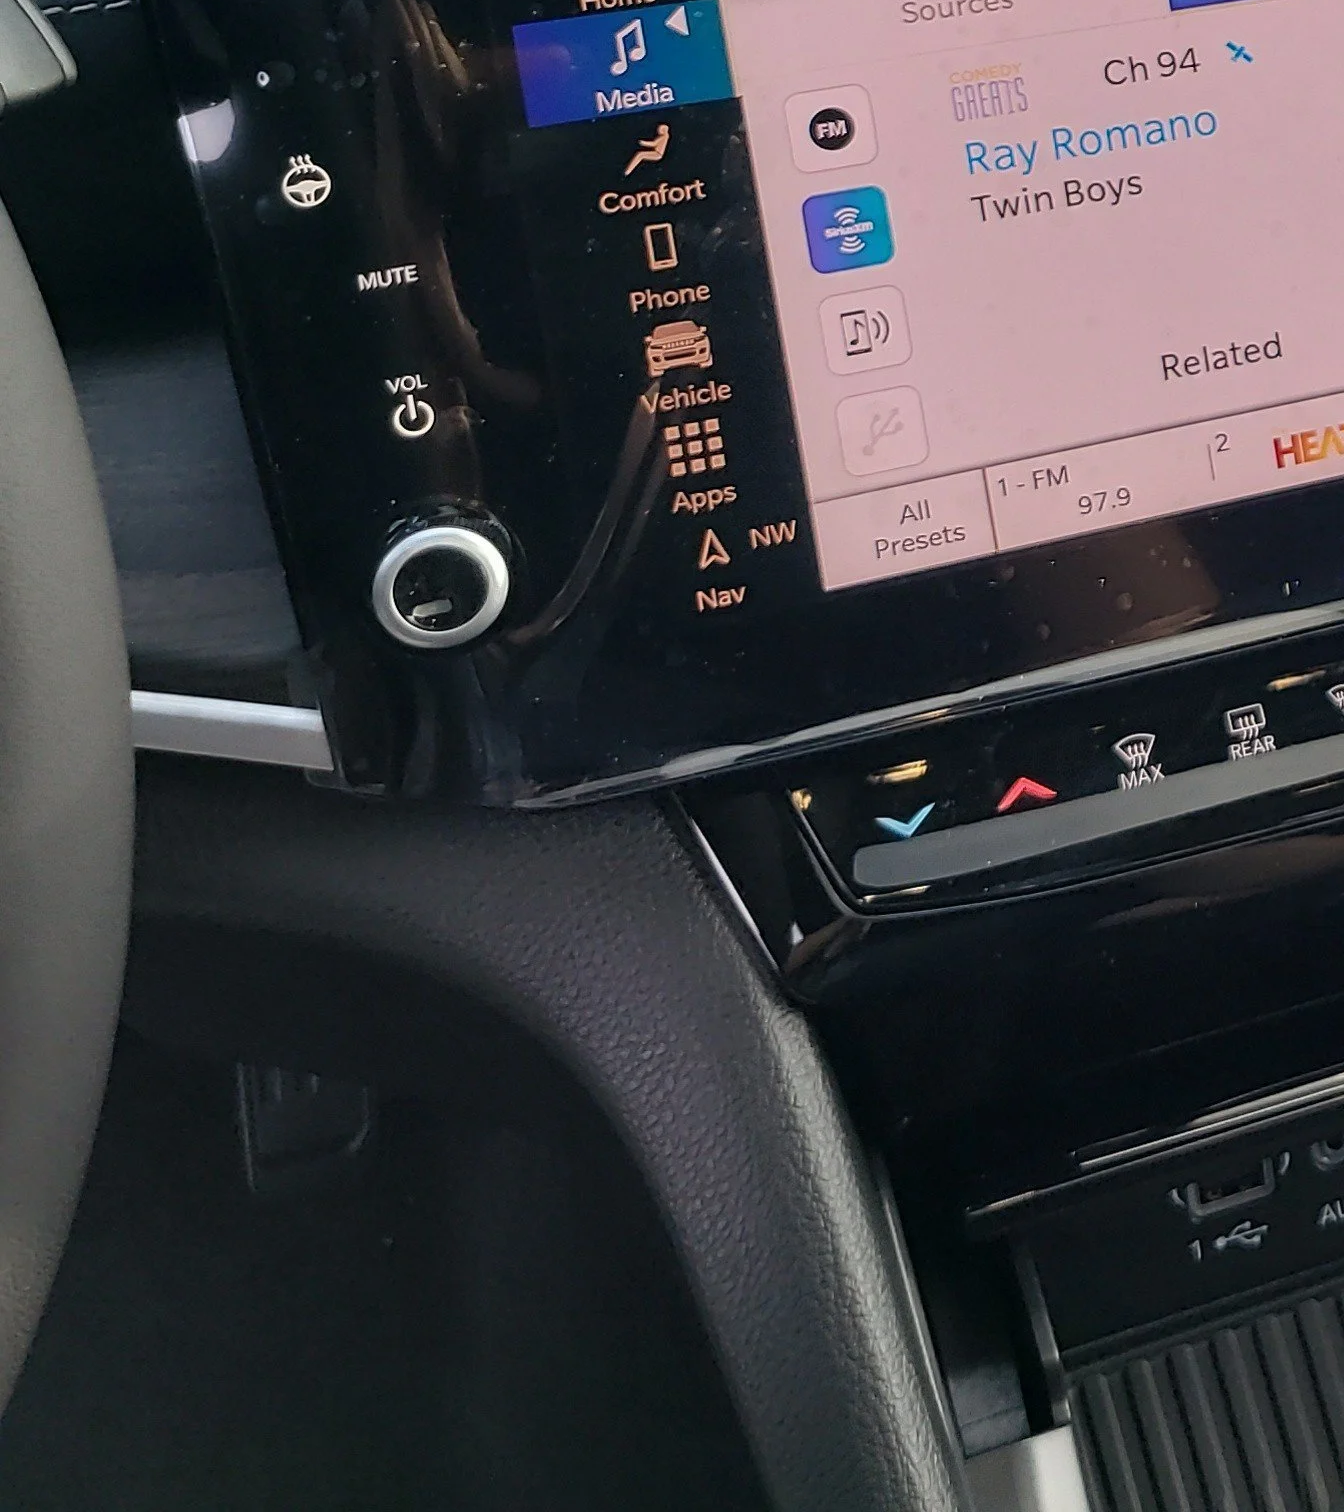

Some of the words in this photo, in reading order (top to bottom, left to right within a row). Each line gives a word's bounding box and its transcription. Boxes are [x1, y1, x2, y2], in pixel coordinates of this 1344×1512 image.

[949, 63, 1021, 83] COMEDY
[1103, 56, 1151, 86] Ch
[1158, 47, 1202, 78] 94
[595, 83, 676, 114] Media
[951, 77, 1028, 121] GREATS
[815, 119, 847, 139] FM
[965, 134, 1040, 177] Ray
[1053, 108, 1219, 158] Romano
[600, 179, 707, 215] Comfort
[970, 186, 1056, 224] Twin
[1062, 171, 1144, 209] Boys
[357, 264, 419, 292] MUTE
[630, 281, 710, 314] Phone
[1160, 333, 1284, 380] Related
[385, 375, 428, 392] VOL
[640, 380, 733, 414] Vehicle
[1215, 433, 1230, 454] 2
[998, 477, 1008, 497] 1
[1031, 465, 1071, 490] FM
[671, 483, 738, 515] Apps
[900, 500, 932, 526] All
[1078, 488, 1133, 516] 97.9
[750, 521, 798, 549] NW
[875, 524, 967, 560] Presets
[695, 583, 746, 613] Nav
[1229, 734, 1276, 758] REAR
[1117, 763, 1165, 789] MAX
[1190, 1239, 1201, 1261] 1
